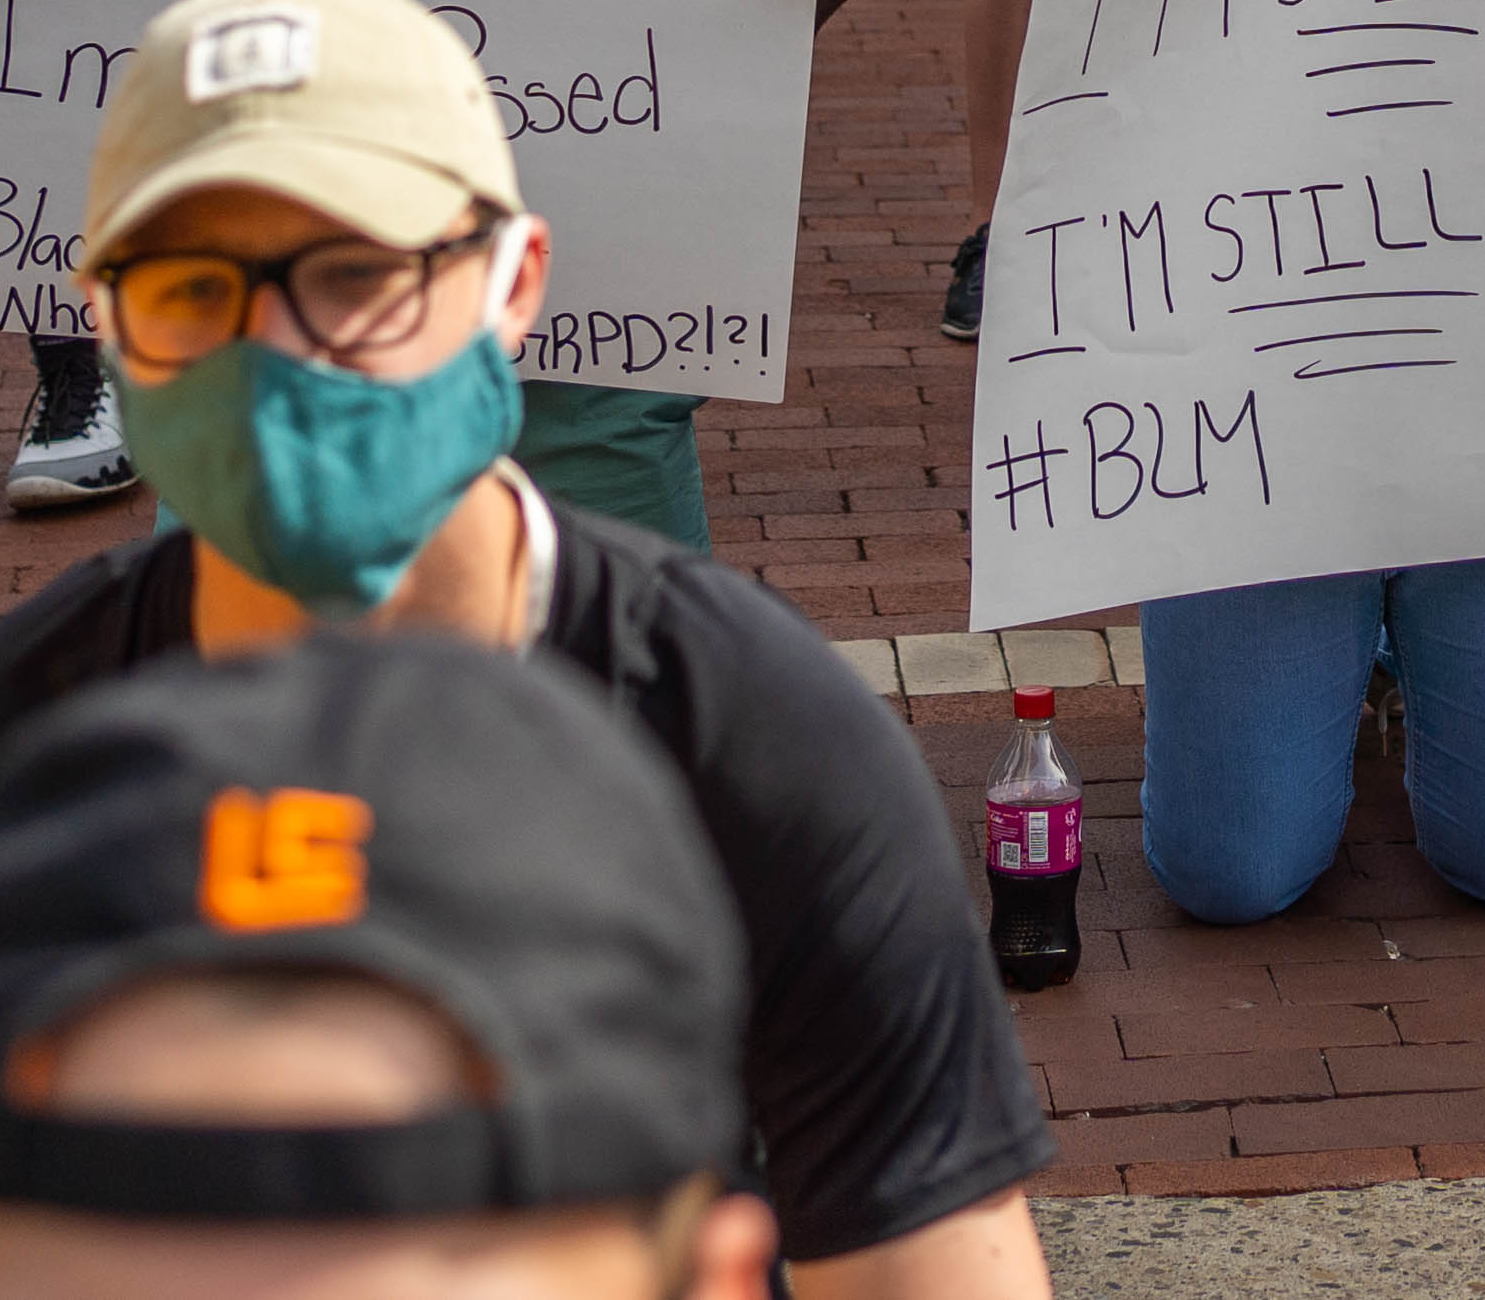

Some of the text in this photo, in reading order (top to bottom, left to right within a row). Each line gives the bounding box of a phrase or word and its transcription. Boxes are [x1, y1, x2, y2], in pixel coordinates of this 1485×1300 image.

[429, 4, 662, 139] ssed
[1009, 199, 1173, 363] I'M
[1204, 168, 1483, 283] STILL
[986, 389, 1271, 532] #BLM
